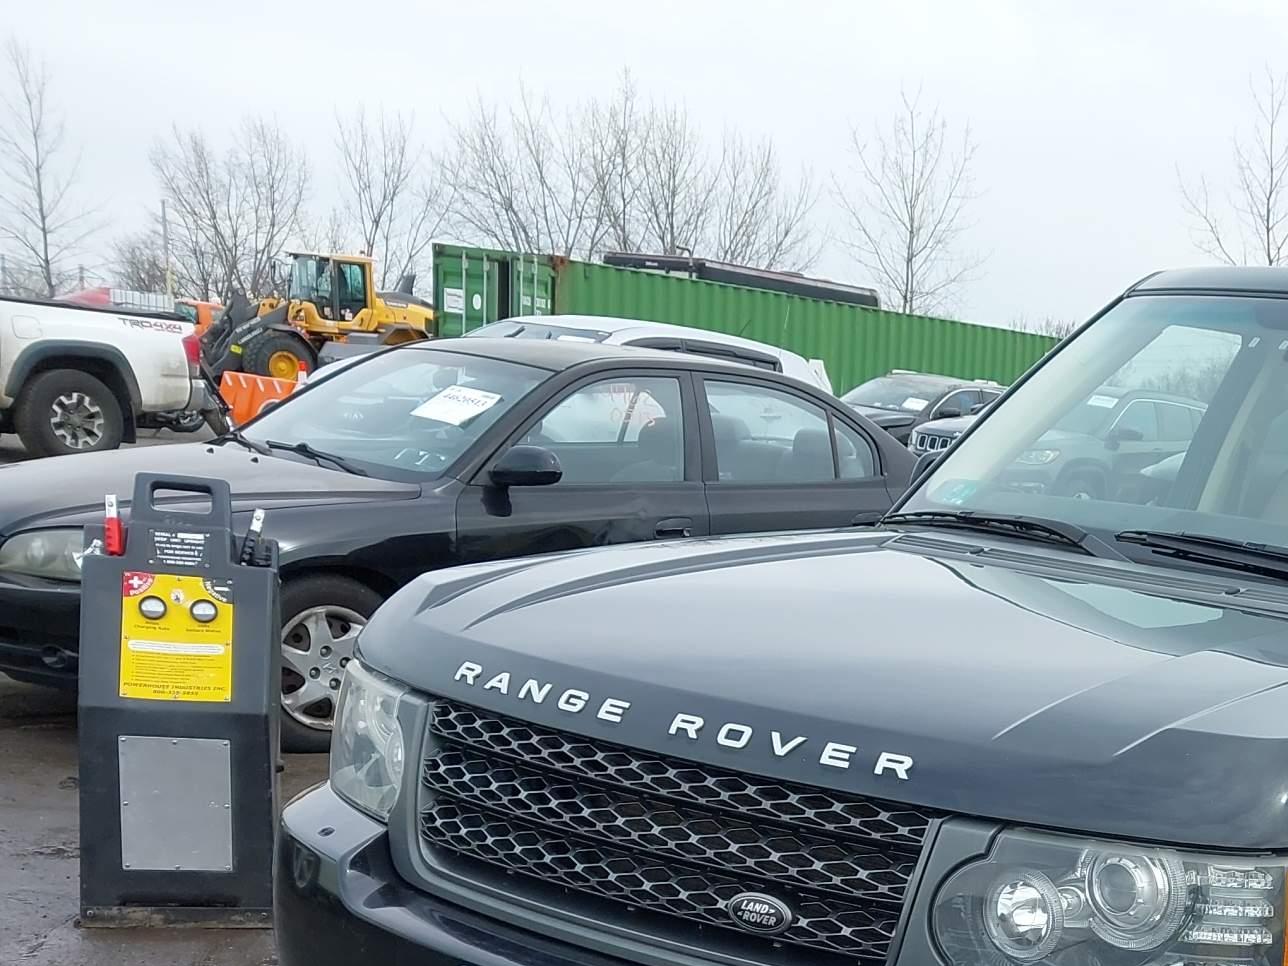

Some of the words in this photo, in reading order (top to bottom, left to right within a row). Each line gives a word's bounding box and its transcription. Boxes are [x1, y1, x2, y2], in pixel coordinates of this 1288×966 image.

[454, 661, 631, 723] RANGE
[668, 712, 913, 780] ROVER
[741, 900, 769, 914] LAND
[742, 911, 777, 926] ROVER
